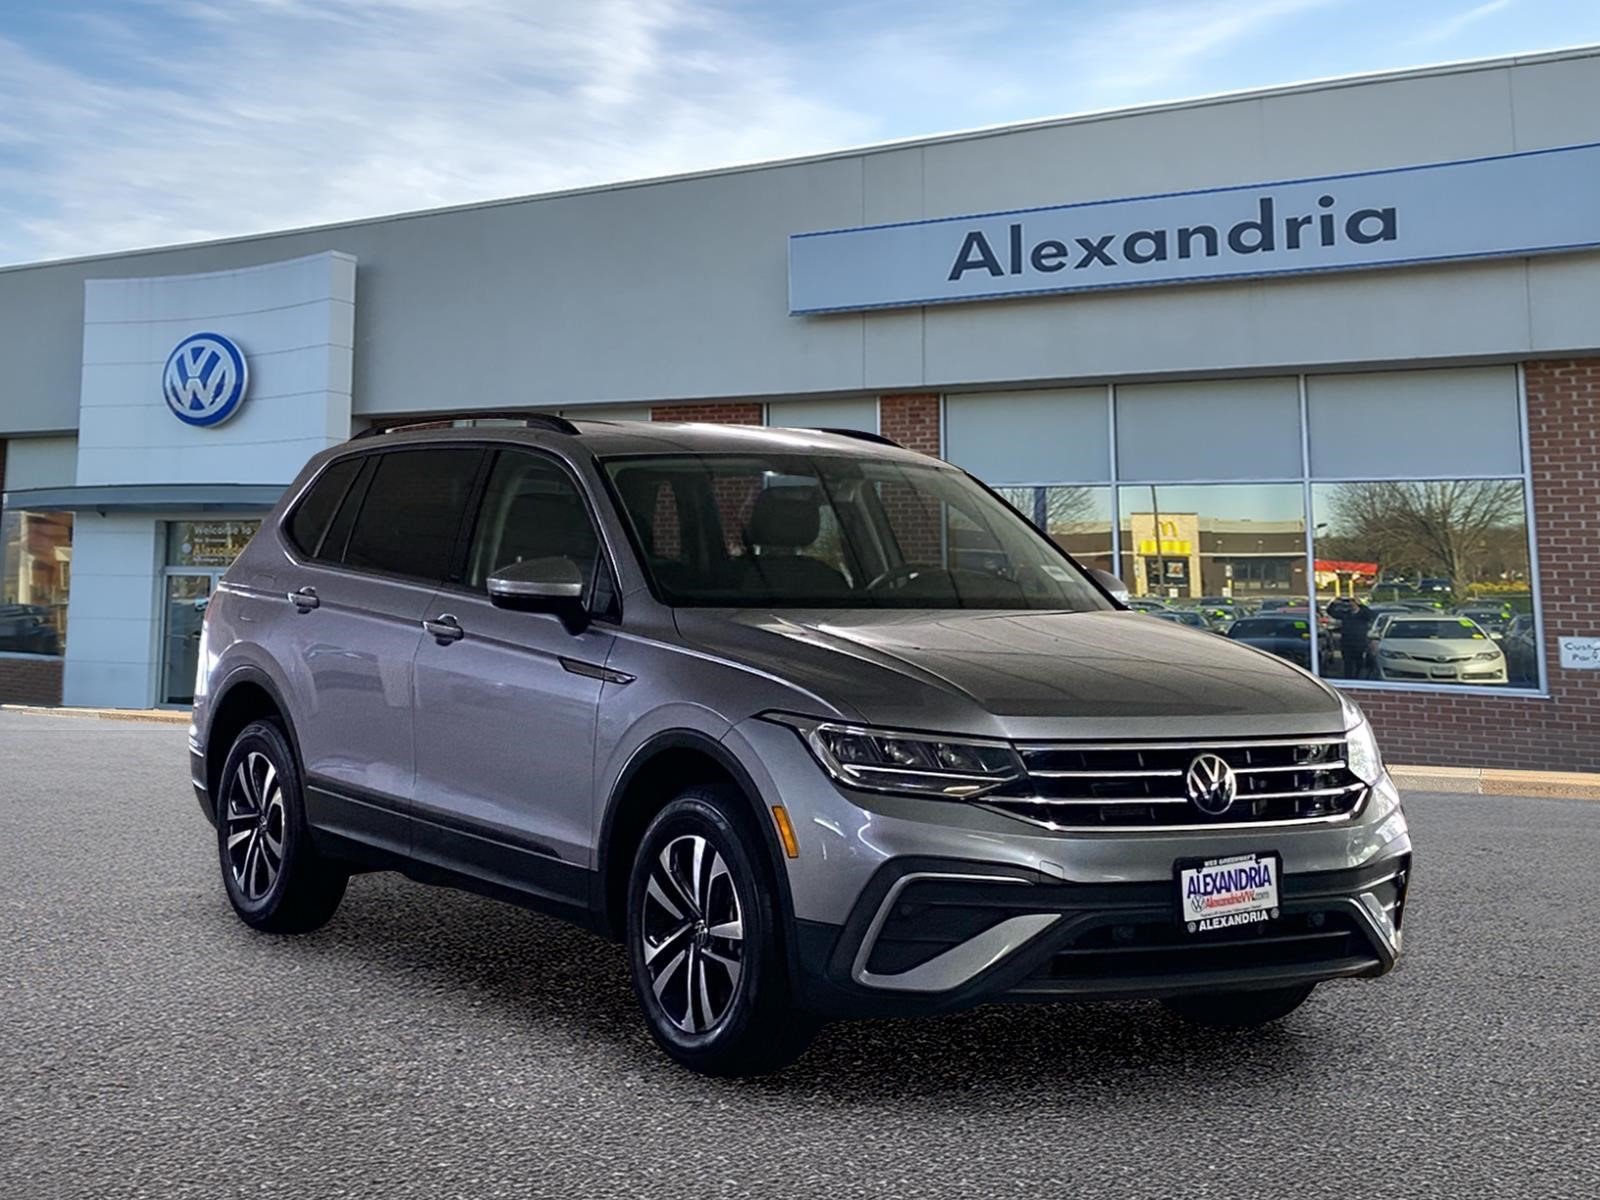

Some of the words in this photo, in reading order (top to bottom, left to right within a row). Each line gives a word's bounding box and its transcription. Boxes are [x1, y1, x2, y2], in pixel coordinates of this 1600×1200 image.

[948, 195, 1397, 282] Alexandria
[165, 337, 239, 420] VW
[195, 526, 239, 535] Welcome
[1188, 754, 1236, 814] VW
[1187, 864, 1272, 899] ALEXANDRIA
[1199, 910, 1269, 931] ALEXANDRIA
